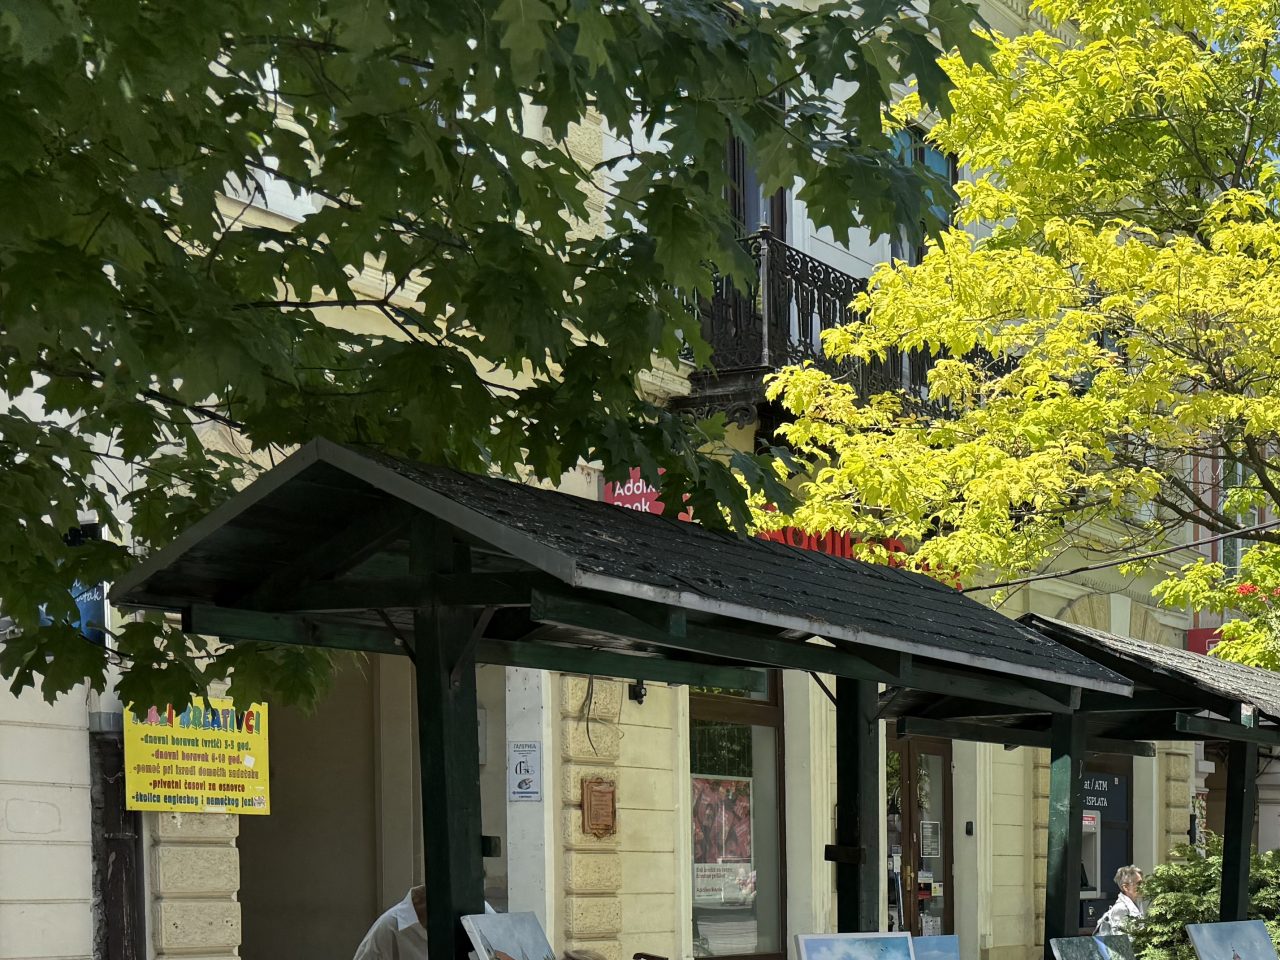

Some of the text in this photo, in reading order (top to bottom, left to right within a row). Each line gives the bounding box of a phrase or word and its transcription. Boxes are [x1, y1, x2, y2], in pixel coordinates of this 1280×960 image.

[615, 479, 660, 496] Addi
[179, 703, 260, 734] KREATIVCI
[163, 764, 174, 776] pri
[1095, 780, 1108, 791] ATM
[1086, 796, 1108, 807] ISPLATA
